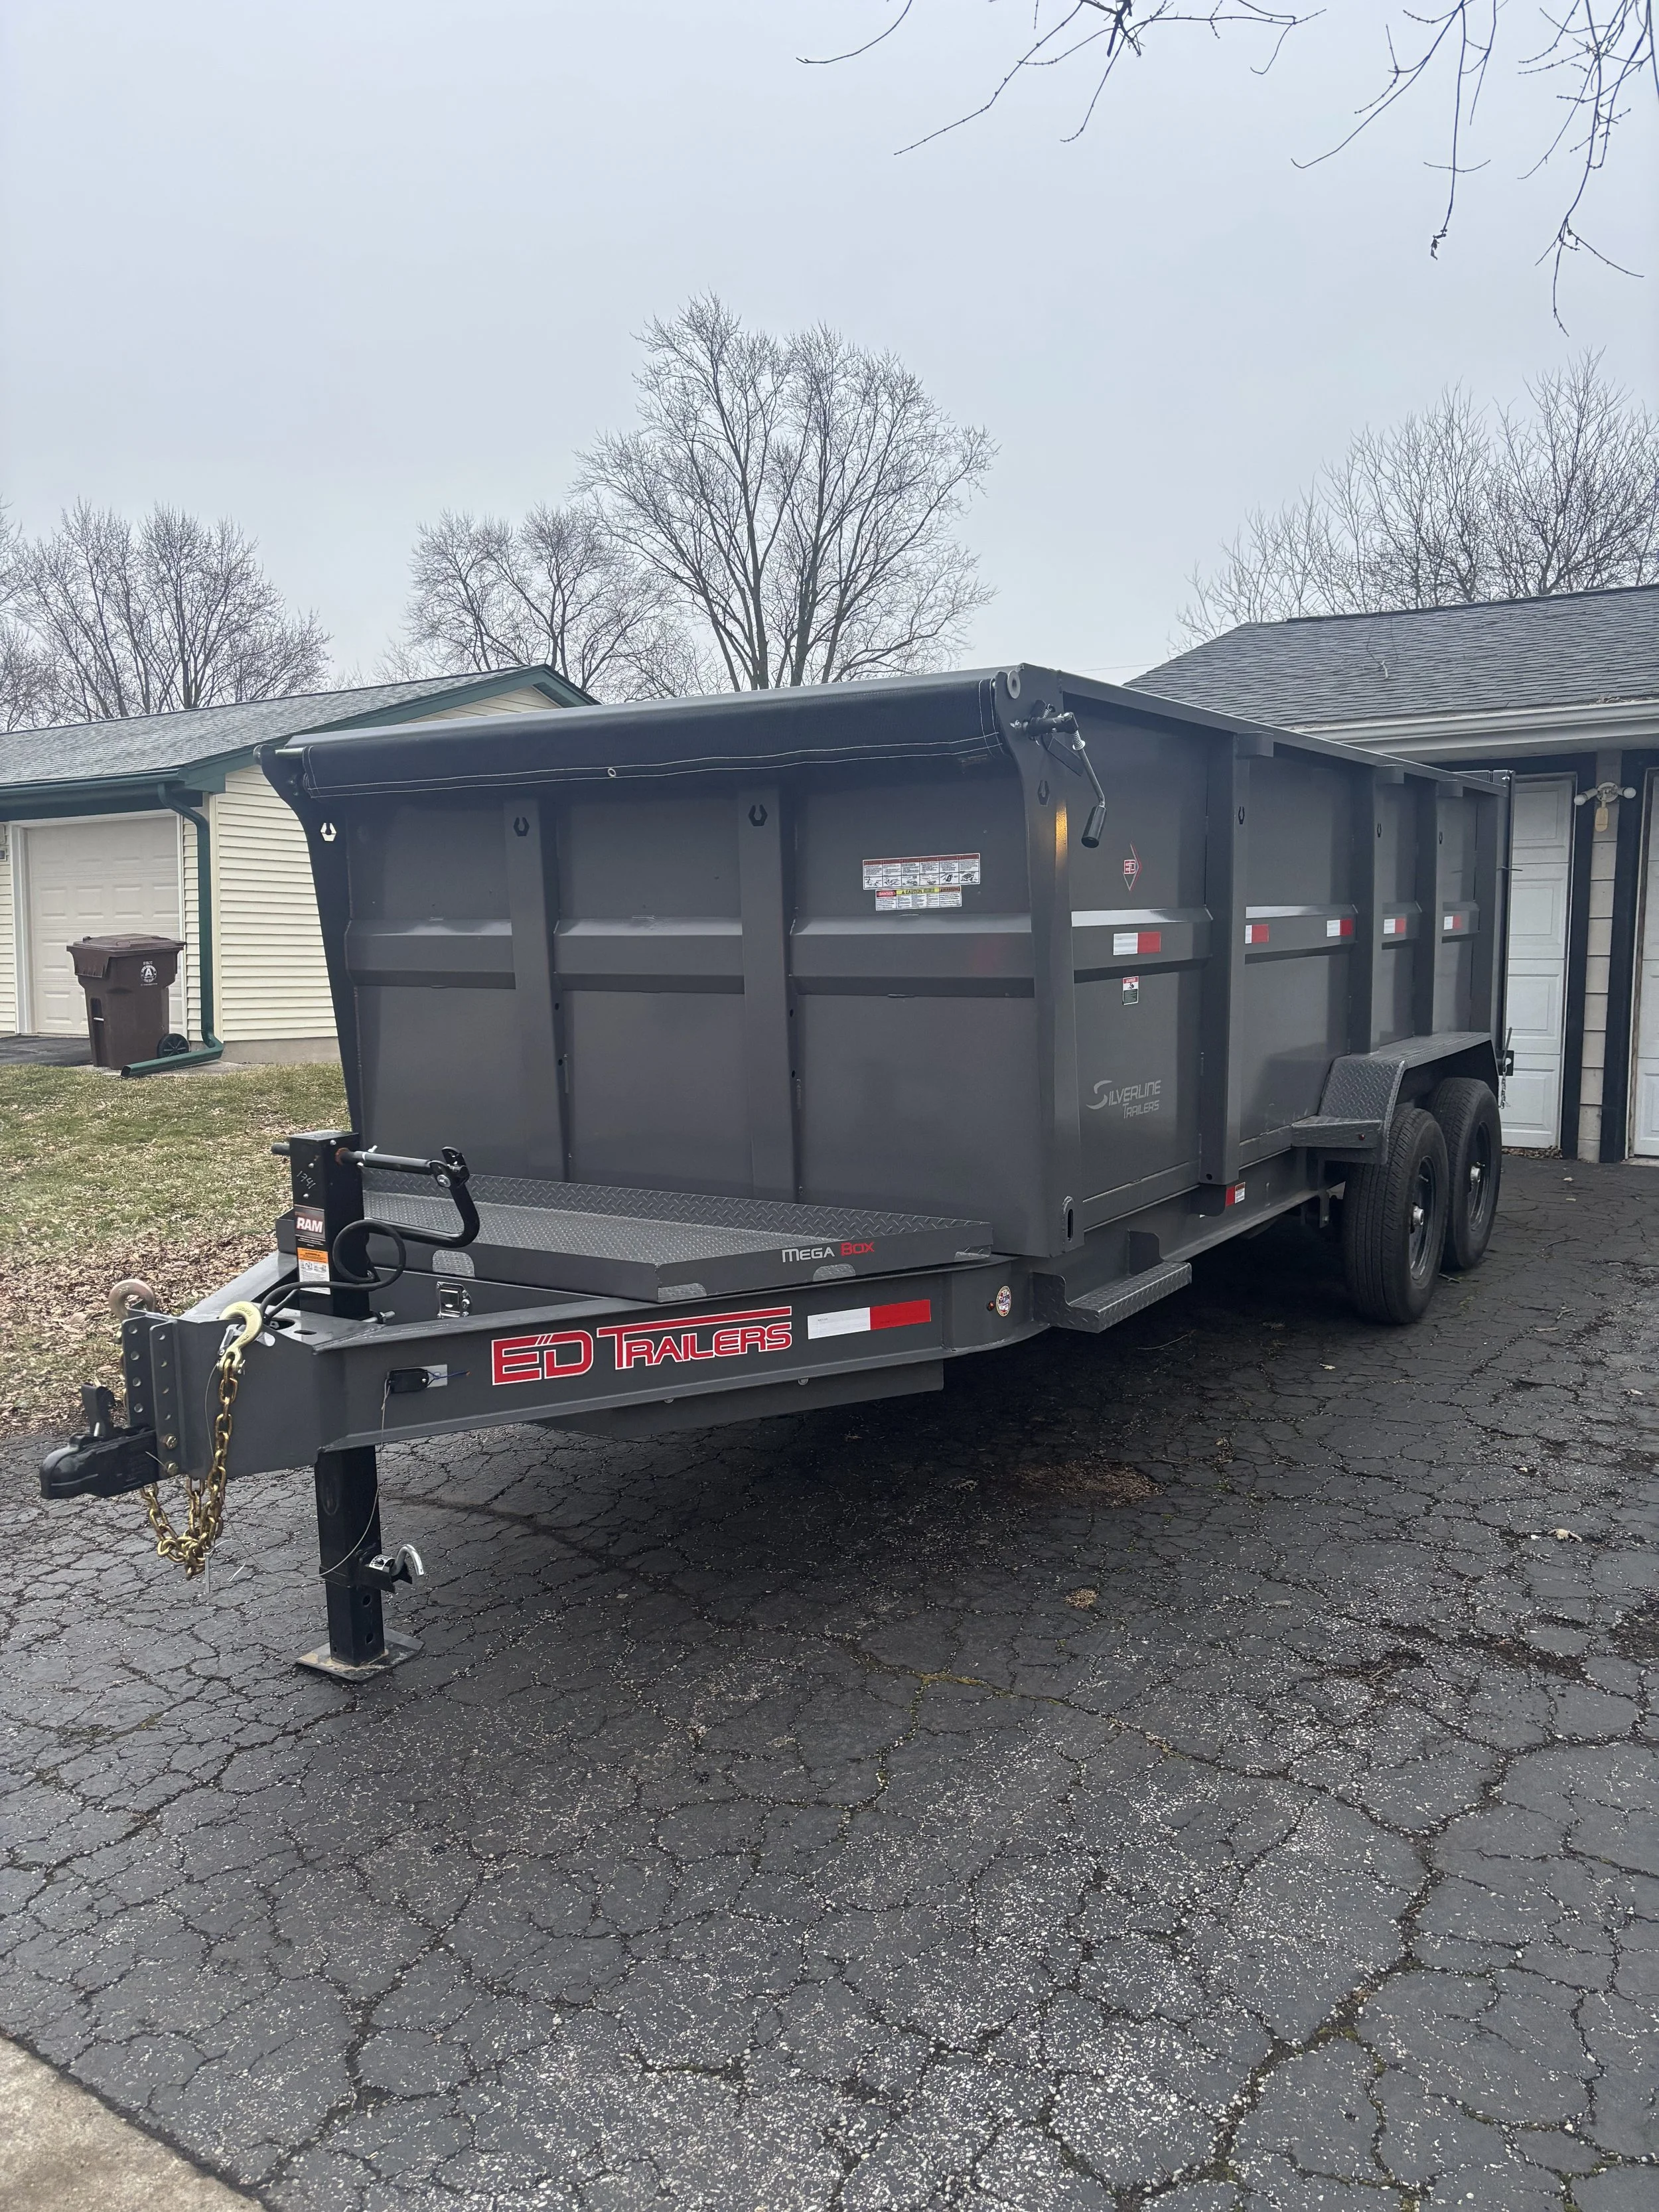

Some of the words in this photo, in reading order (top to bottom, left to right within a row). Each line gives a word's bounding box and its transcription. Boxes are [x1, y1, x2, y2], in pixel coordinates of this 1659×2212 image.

[1086, 1080, 1161, 1110] SILVERLINE
[1122, 1100, 1160, 1119] TRAILERS
[297, 1217, 323, 1233] RAM
[782, 1247, 835, 1262] MEGA
[841, 1242, 875, 1256] BOX
[597, 1306, 792, 1370] TRAILERS
